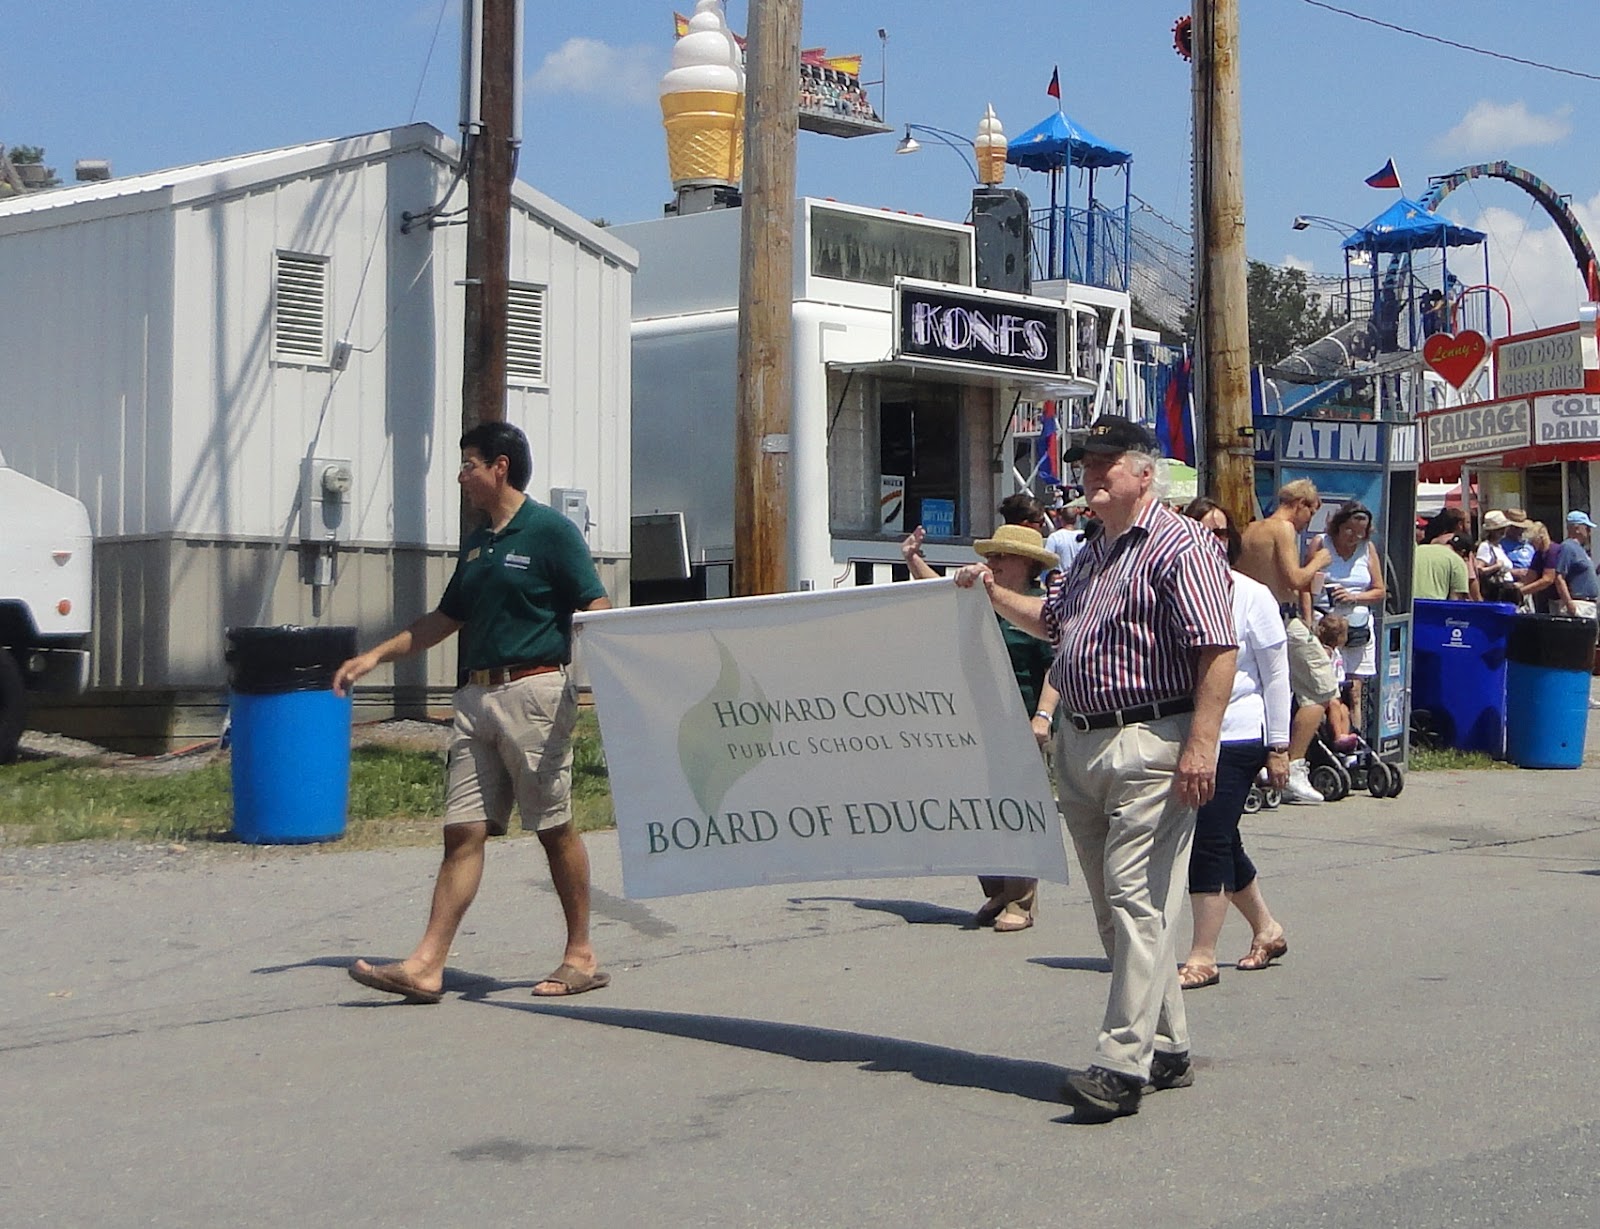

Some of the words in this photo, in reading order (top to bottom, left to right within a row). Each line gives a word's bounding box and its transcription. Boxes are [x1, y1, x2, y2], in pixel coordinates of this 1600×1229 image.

[911, 302, 1049, 361] KONES
[1430, 402, 1528, 447] SAUSAGE
[1552, 397, 1600, 417] COL
[1285, 421, 1378, 462] ATM
[1541, 420, 1600, 441] DRIN
[712, 697, 837, 729] HOWARD
[842, 690, 957, 719] COUNTY
[727, 740, 802, 760] PUBLIC
[807, 734, 894, 755] SCHOOL
[899, 730, 978, 749] SYSTEM
[646, 809, 779, 855] BOARD
[788, 805, 834, 839] OF
[844, 797, 1048, 836] EDUCATION
